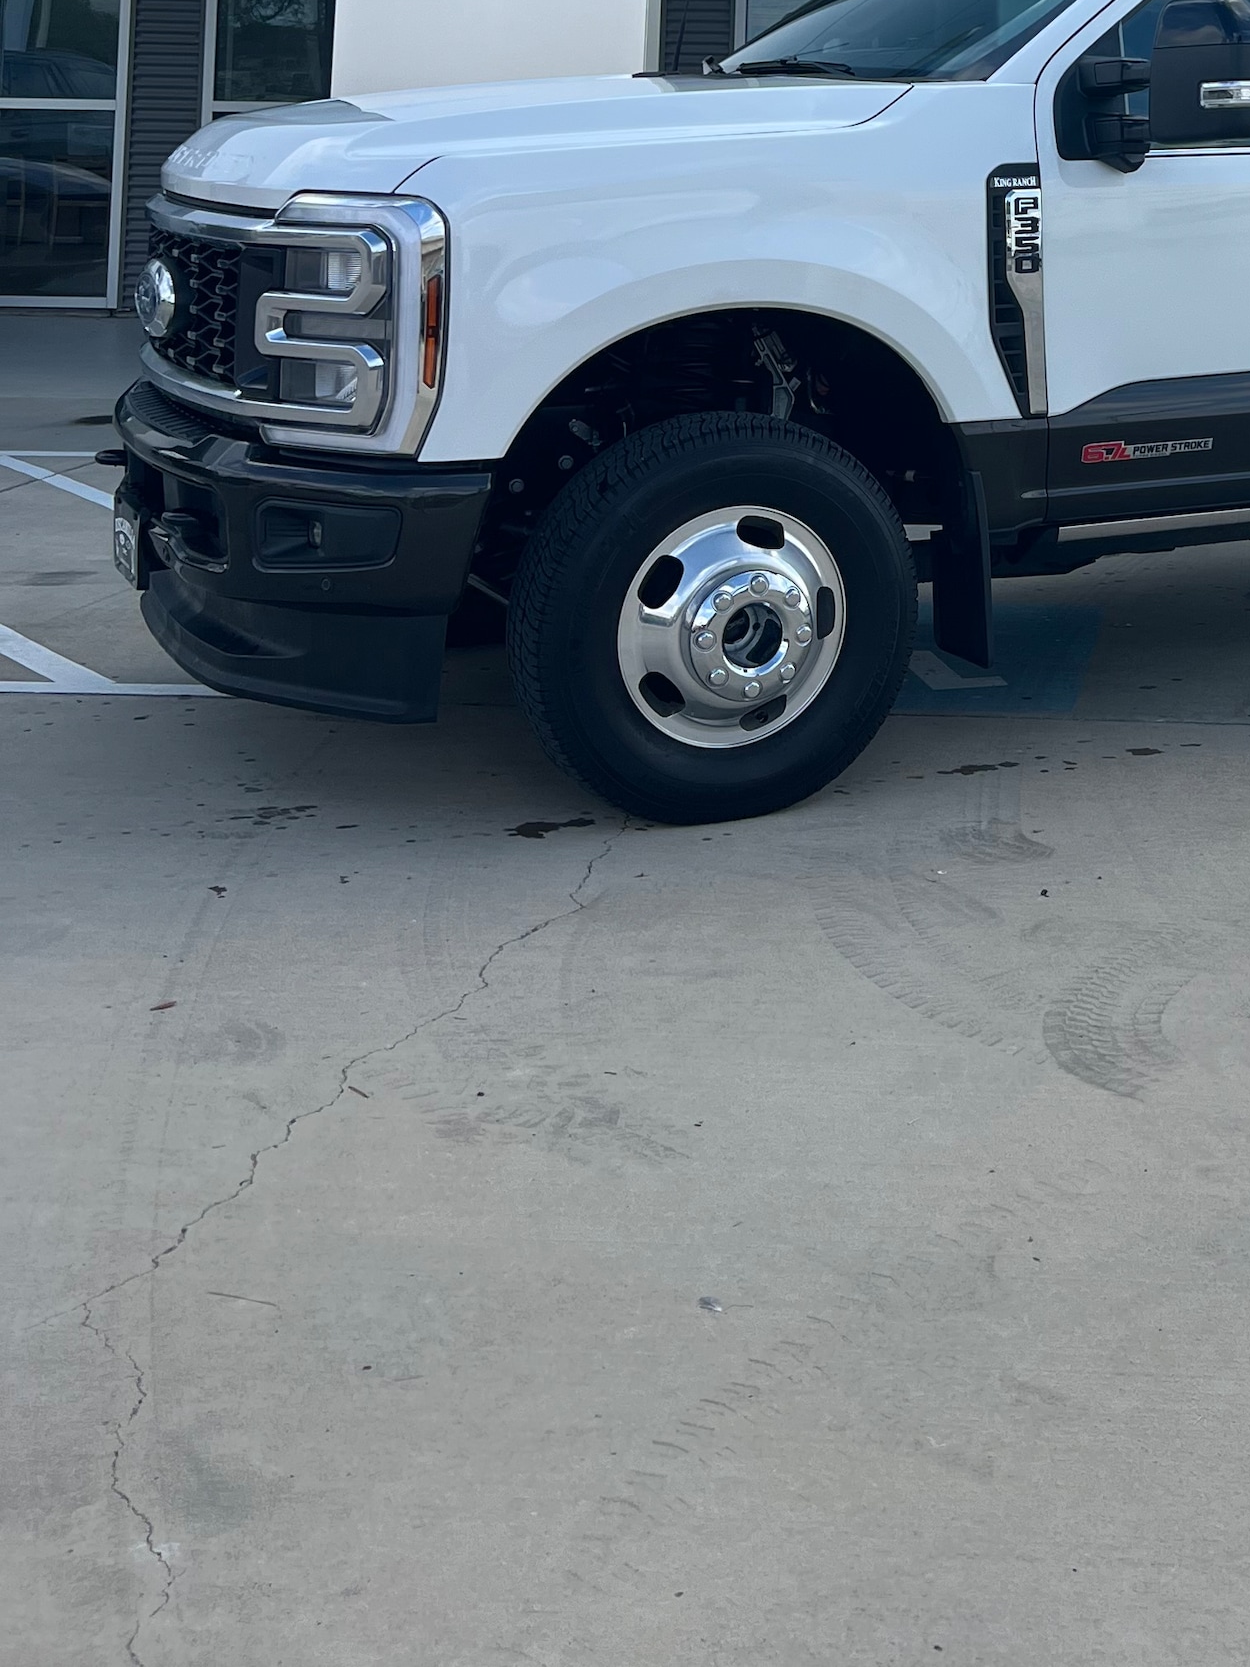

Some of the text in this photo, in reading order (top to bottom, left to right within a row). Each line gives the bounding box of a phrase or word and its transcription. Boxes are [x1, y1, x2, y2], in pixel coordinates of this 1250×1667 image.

[994, 176, 1037, 188] KING RANCH
[1014, 196, 1040, 274] F350
[1132, 444, 1170, 455] POWER
[1170, 439, 1210, 452] STROKE
